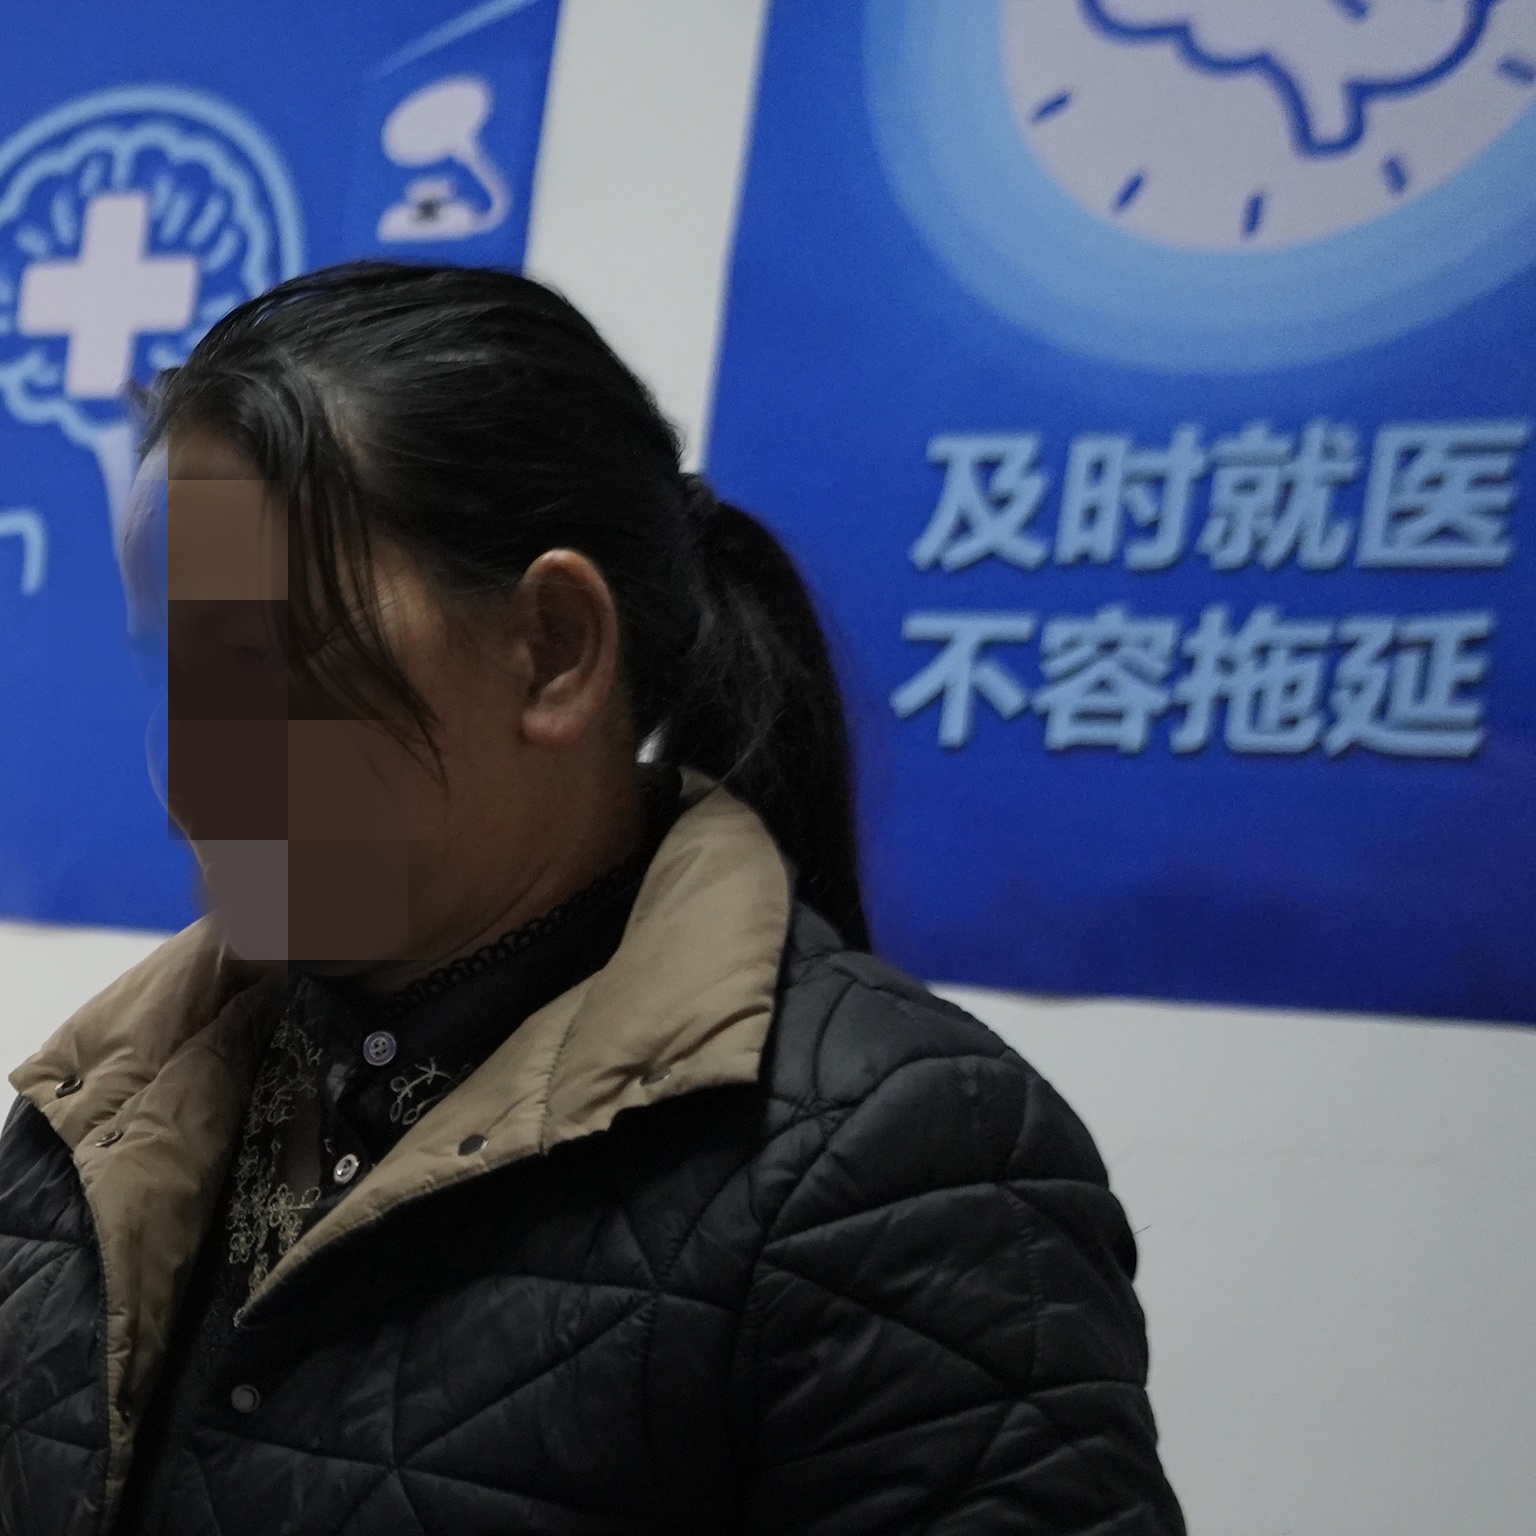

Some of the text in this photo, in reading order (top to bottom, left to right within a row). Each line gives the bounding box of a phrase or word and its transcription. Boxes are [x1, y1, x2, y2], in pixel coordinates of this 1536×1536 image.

[909, 418, 1530, 573] 及时就医
[889, 604, 1496, 760] 不容拖延
